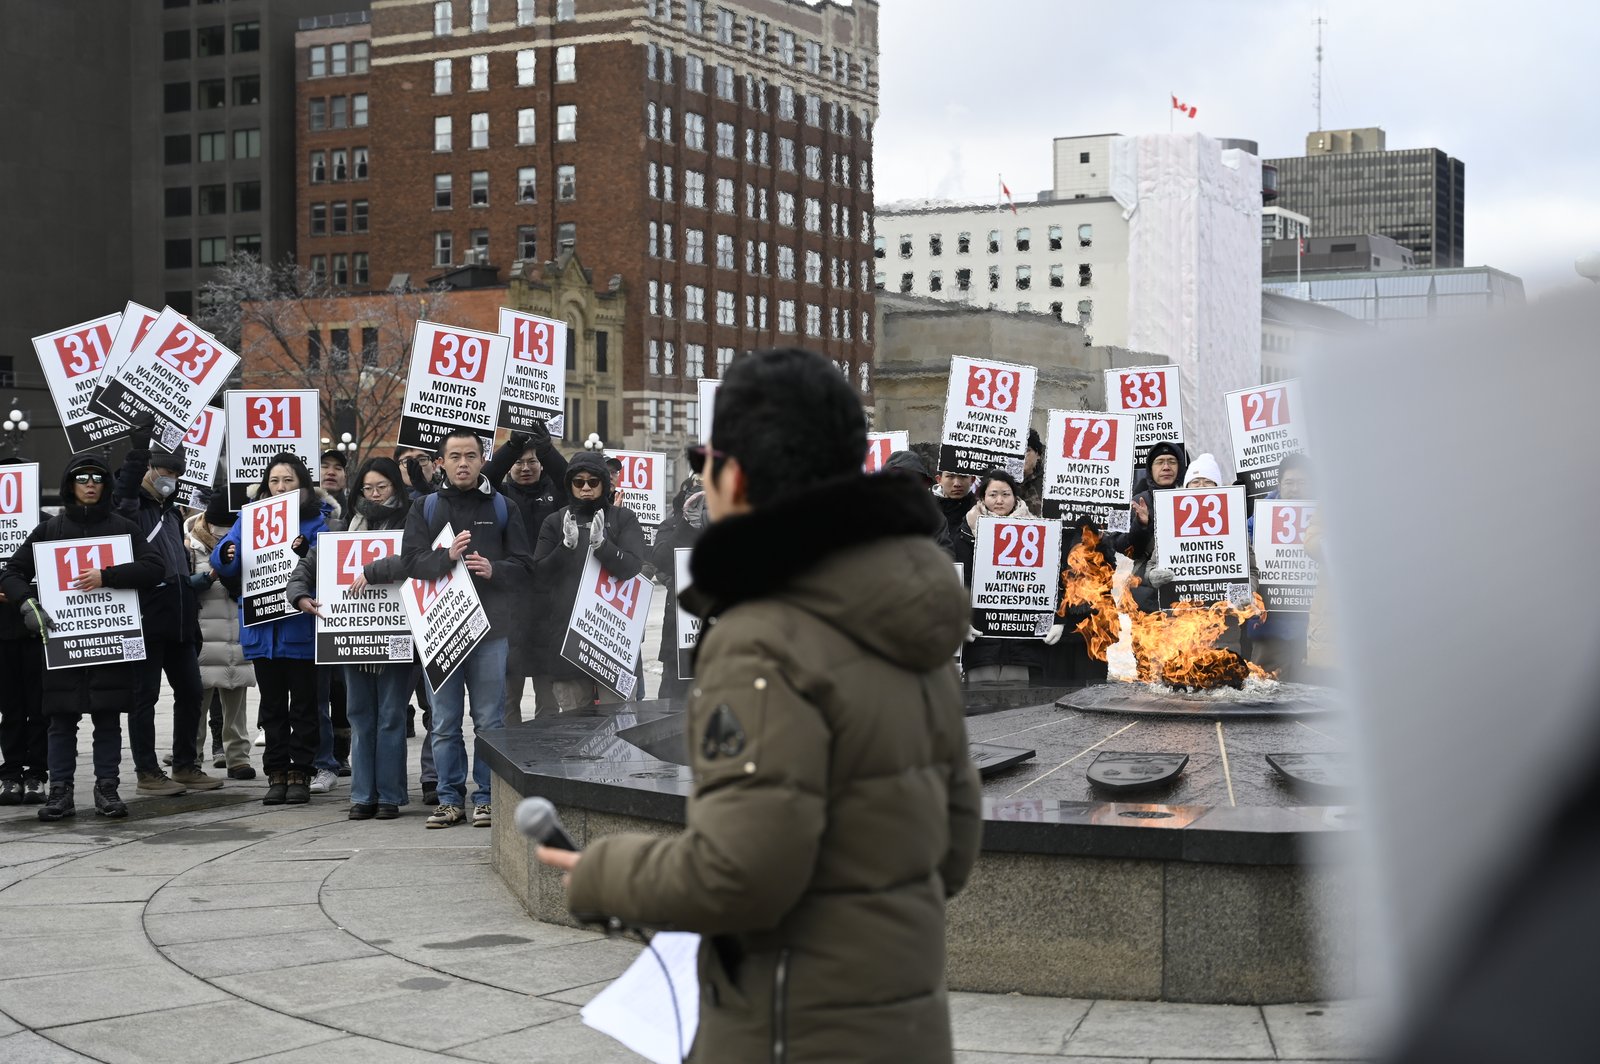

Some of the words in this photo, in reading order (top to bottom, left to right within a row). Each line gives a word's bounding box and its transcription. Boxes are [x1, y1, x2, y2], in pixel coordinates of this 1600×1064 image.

[518, 320, 548, 363] 13
[64, 327, 106, 374] 31
[160, 330, 214, 378] 23
[436, 334, 482, 380] 39
[151, 362, 190, 392] MONTHS
[516, 365, 548, 380] MONTHS
[136, 365, 173, 396] WAITING
[172, 390, 192, 409] FOR
[432, 380, 476, 397] MONTHS
[507, 376, 539, 390] WAITING
[540, 382, 556, 394] FOR
[971, 368, 1014, 410] 38
[1125, 372, 1162, 408] 33
[68, 392, 92, 406] WAIT
[120, 391, 134, 403] NO
[122, 372, 145, 390] IRCC
[143, 386, 190, 422] RESPONSE
[419, 391, 463, 408] WAITING
[465, 400, 486, 412] FOR
[520, 390, 560, 406] RESPONSE
[118, 402, 130, 413] NO
[410, 402, 434, 415] IRCC
[434, 408, 490, 425] RESPONSE
[508, 405, 518, 414] NO
[518, 406, 552, 420] TIMELINES
[1247, 389, 1282, 430] 27
[252, 398, 296, 438] 31
[510, 416, 520, 424] NO
[968, 411, 1008, 424] MONTHS
[82, 422, 95, 432] NO
[187, 410, 206, 444] 9
[418, 422, 430, 432] NO
[956, 421, 996, 434] WAITING
[998, 427, 1017, 438] FOR
[1156, 422, 1173, 430] FOR
[89, 431, 102, 442] NO
[420, 434, 432, 443] NO
[948, 432, 970, 443] IRCC
[971, 435, 1021, 450] RESPONSE
[1070, 420, 1111, 460] 72
[1251, 430, 1288, 444] MONTHS
[252, 444, 296, 454] MONTHS
[955, 450, 967, 458] NO
[1244, 442, 1280, 456] WAITING
[1282, 438, 1298, 450] FOR
[189, 458, 206, 470] FOR
[956, 460, 969, 468] NO
[1068, 464, 1110, 474] MONTHS
[1240, 456, 1260, 468] IRCC
[236, 468, 258, 478] IRCC
[620, 456, 648, 488] 16
[1250, 472, 1260, 480] NO
[1056, 474, 1098, 486] WAITING
[1100, 478, 1120, 487] FOR
[1049, 486, 1072, 496] IRCC
[1073, 488, 1124, 500] RESPONSE
[642, 503, 656, 511] FOR
[1061, 512, 1072, 520] NO
[1180, 494, 1223, 536] 23
[256, 502, 284, 548] 35
[998, 526, 1039, 566] 28
[1180, 540, 1224, 551] MONTHS
[256, 549, 284, 564] MONTHS
[1170, 553, 1213, 564] WAITING
[1216, 552, 1236, 562] FOR
[64, 545, 102, 590] 11
[250, 563, 277, 579] WAITING
[278, 560, 292, 572] FOR
[1188, 564, 1242, 576] RESPONSE
[1264, 560, 1306, 570] WAITING
[246, 580, 260, 592] IRCC
[260, 572, 291, 588] RESPONS
[996, 571, 1036, 581] MONTHS
[600, 576, 636, 614] 34
[984, 583, 1024, 594] WAITING
[1027, 584, 1046, 594] FOR
[1175, 584, 1188, 592] NO
[1267, 588, 1279, 596] NO
[66, 592, 112, 606] MONTHS
[252, 598, 260, 608] NO
[977, 595, 999, 604] IRCC
[1000, 595, 1050, 606] RESPONSE
[1179, 594, 1192, 602] NO
[1270, 597, 1282, 605] NO
[56, 606, 102, 620] WAITING
[104, 604, 126, 614] FOR
[256, 608, 264, 617] NO
[331, 602, 376, 614] WAITING
[378, 602, 400, 612] FOR
[426, 588, 454, 625] MONTHS
[76, 616, 134, 630] RESPONSE
[324, 617, 348, 628] IRCC
[349, 616, 406, 626] RESPONSE
[424, 608, 452, 644] WAITING
[450, 590, 466, 612] FOR
[594, 602, 626, 632] MONTHS
[986, 612, 998, 620] NO
[999, 613, 1040, 622] TIMELINES
[424, 637, 440, 660] IRCC
[438, 596, 474, 642] RESPONSE
[584, 608, 615, 638] WAITING
[616, 631, 632, 650] FOR
[988, 622, 1000, 630] NO
[1001, 623, 1034, 632] RESULTS
[64, 640, 76, 649] NO
[78, 635, 124, 647] TIMELINES
[334, 636, 347, 645] NO
[348, 634, 390, 644] TIMELINE
[436, 652, 444, 666] NO
[444, 622, 470, 656] TIMELINE
[576, 617, 594, 636] IRCC
[594, 630, 632, 665] RESPONSE
[69, 650, 82, 660] NO
[84, 646, 122, 658] RESULTS
[338, 647, 350, 656] NO
[578, 640, 588, 652] NO
[588, 645, 620, 676] TIMELINES
[441, 659, 450, 672] NO
[578, 652, 588, 664] NO
[588, 658, 616, 684] RESULTS
